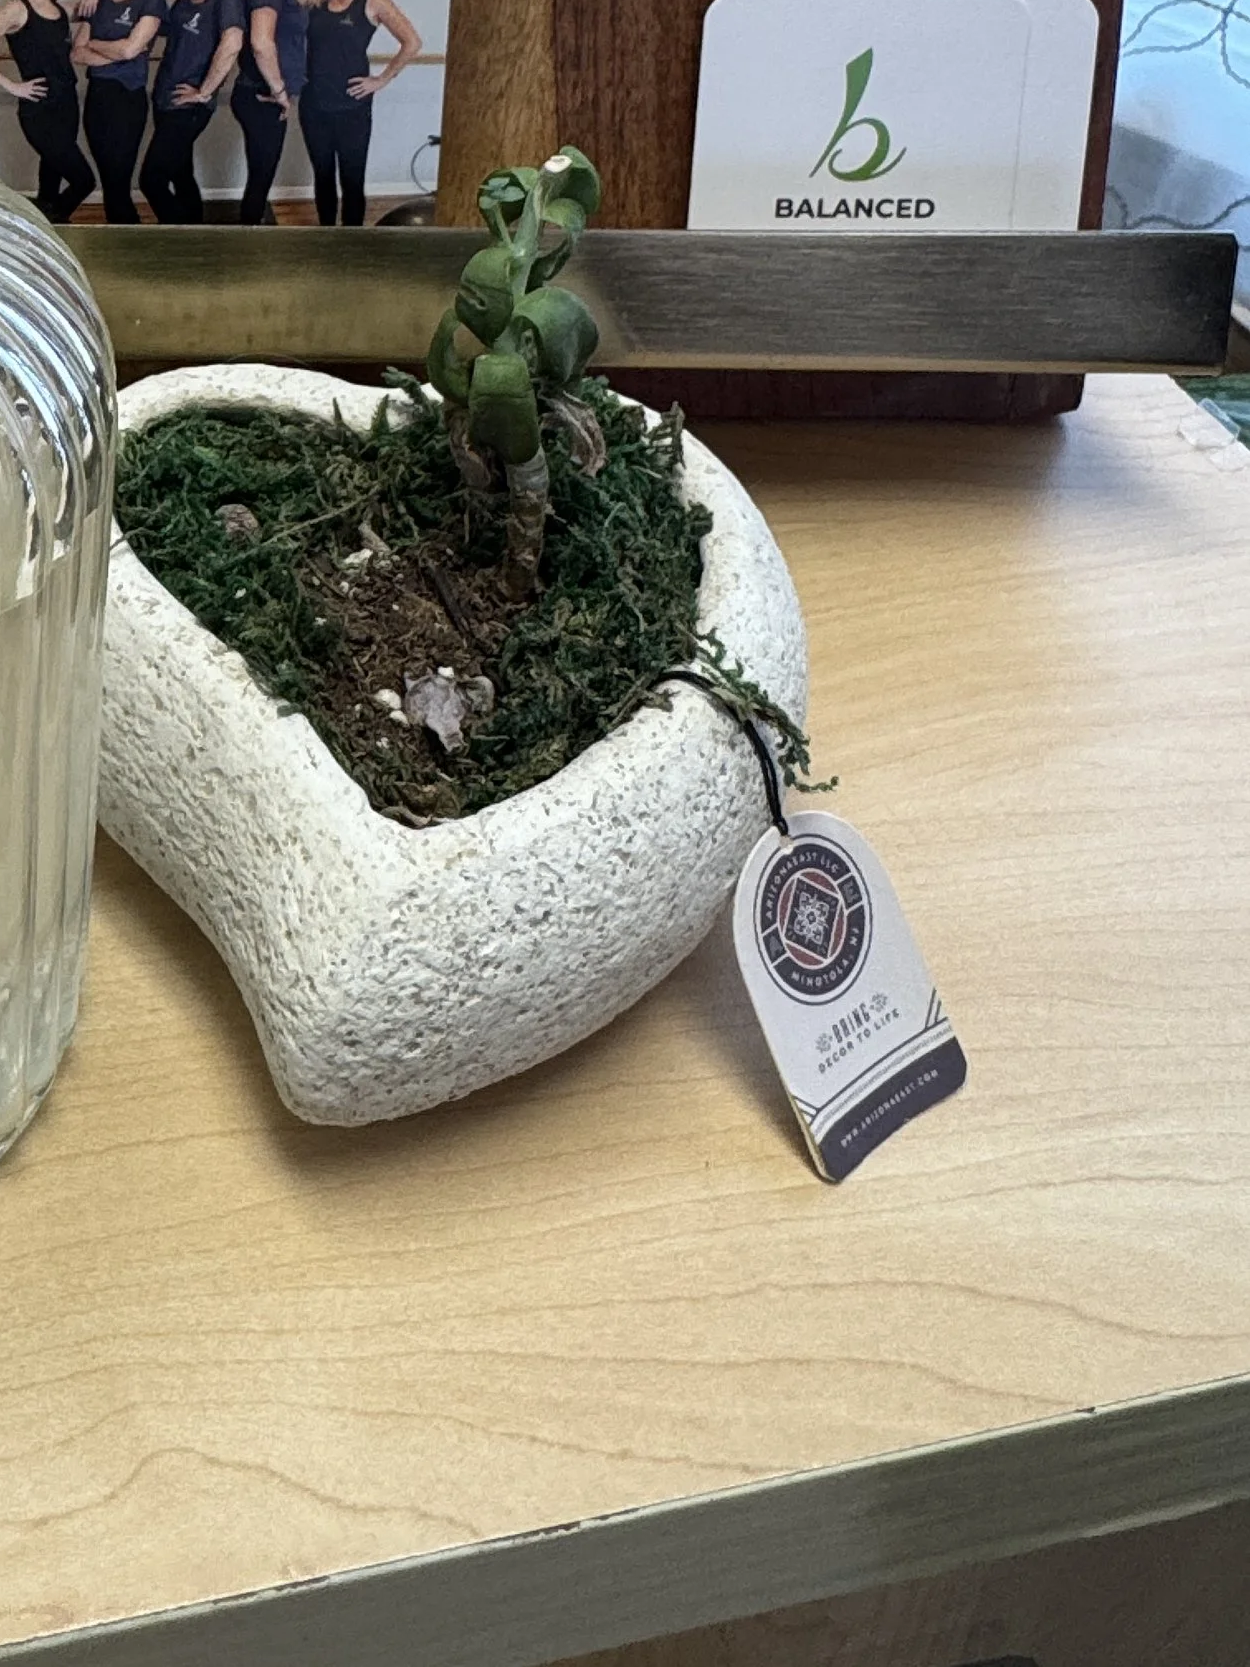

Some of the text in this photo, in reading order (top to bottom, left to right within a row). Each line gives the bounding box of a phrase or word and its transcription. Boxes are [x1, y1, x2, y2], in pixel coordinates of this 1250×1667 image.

[774, 197, 936, 220] BALANCED
[856, 1027, 871, 1043] TO
[873, 1007, 900, 1031] LIFE
